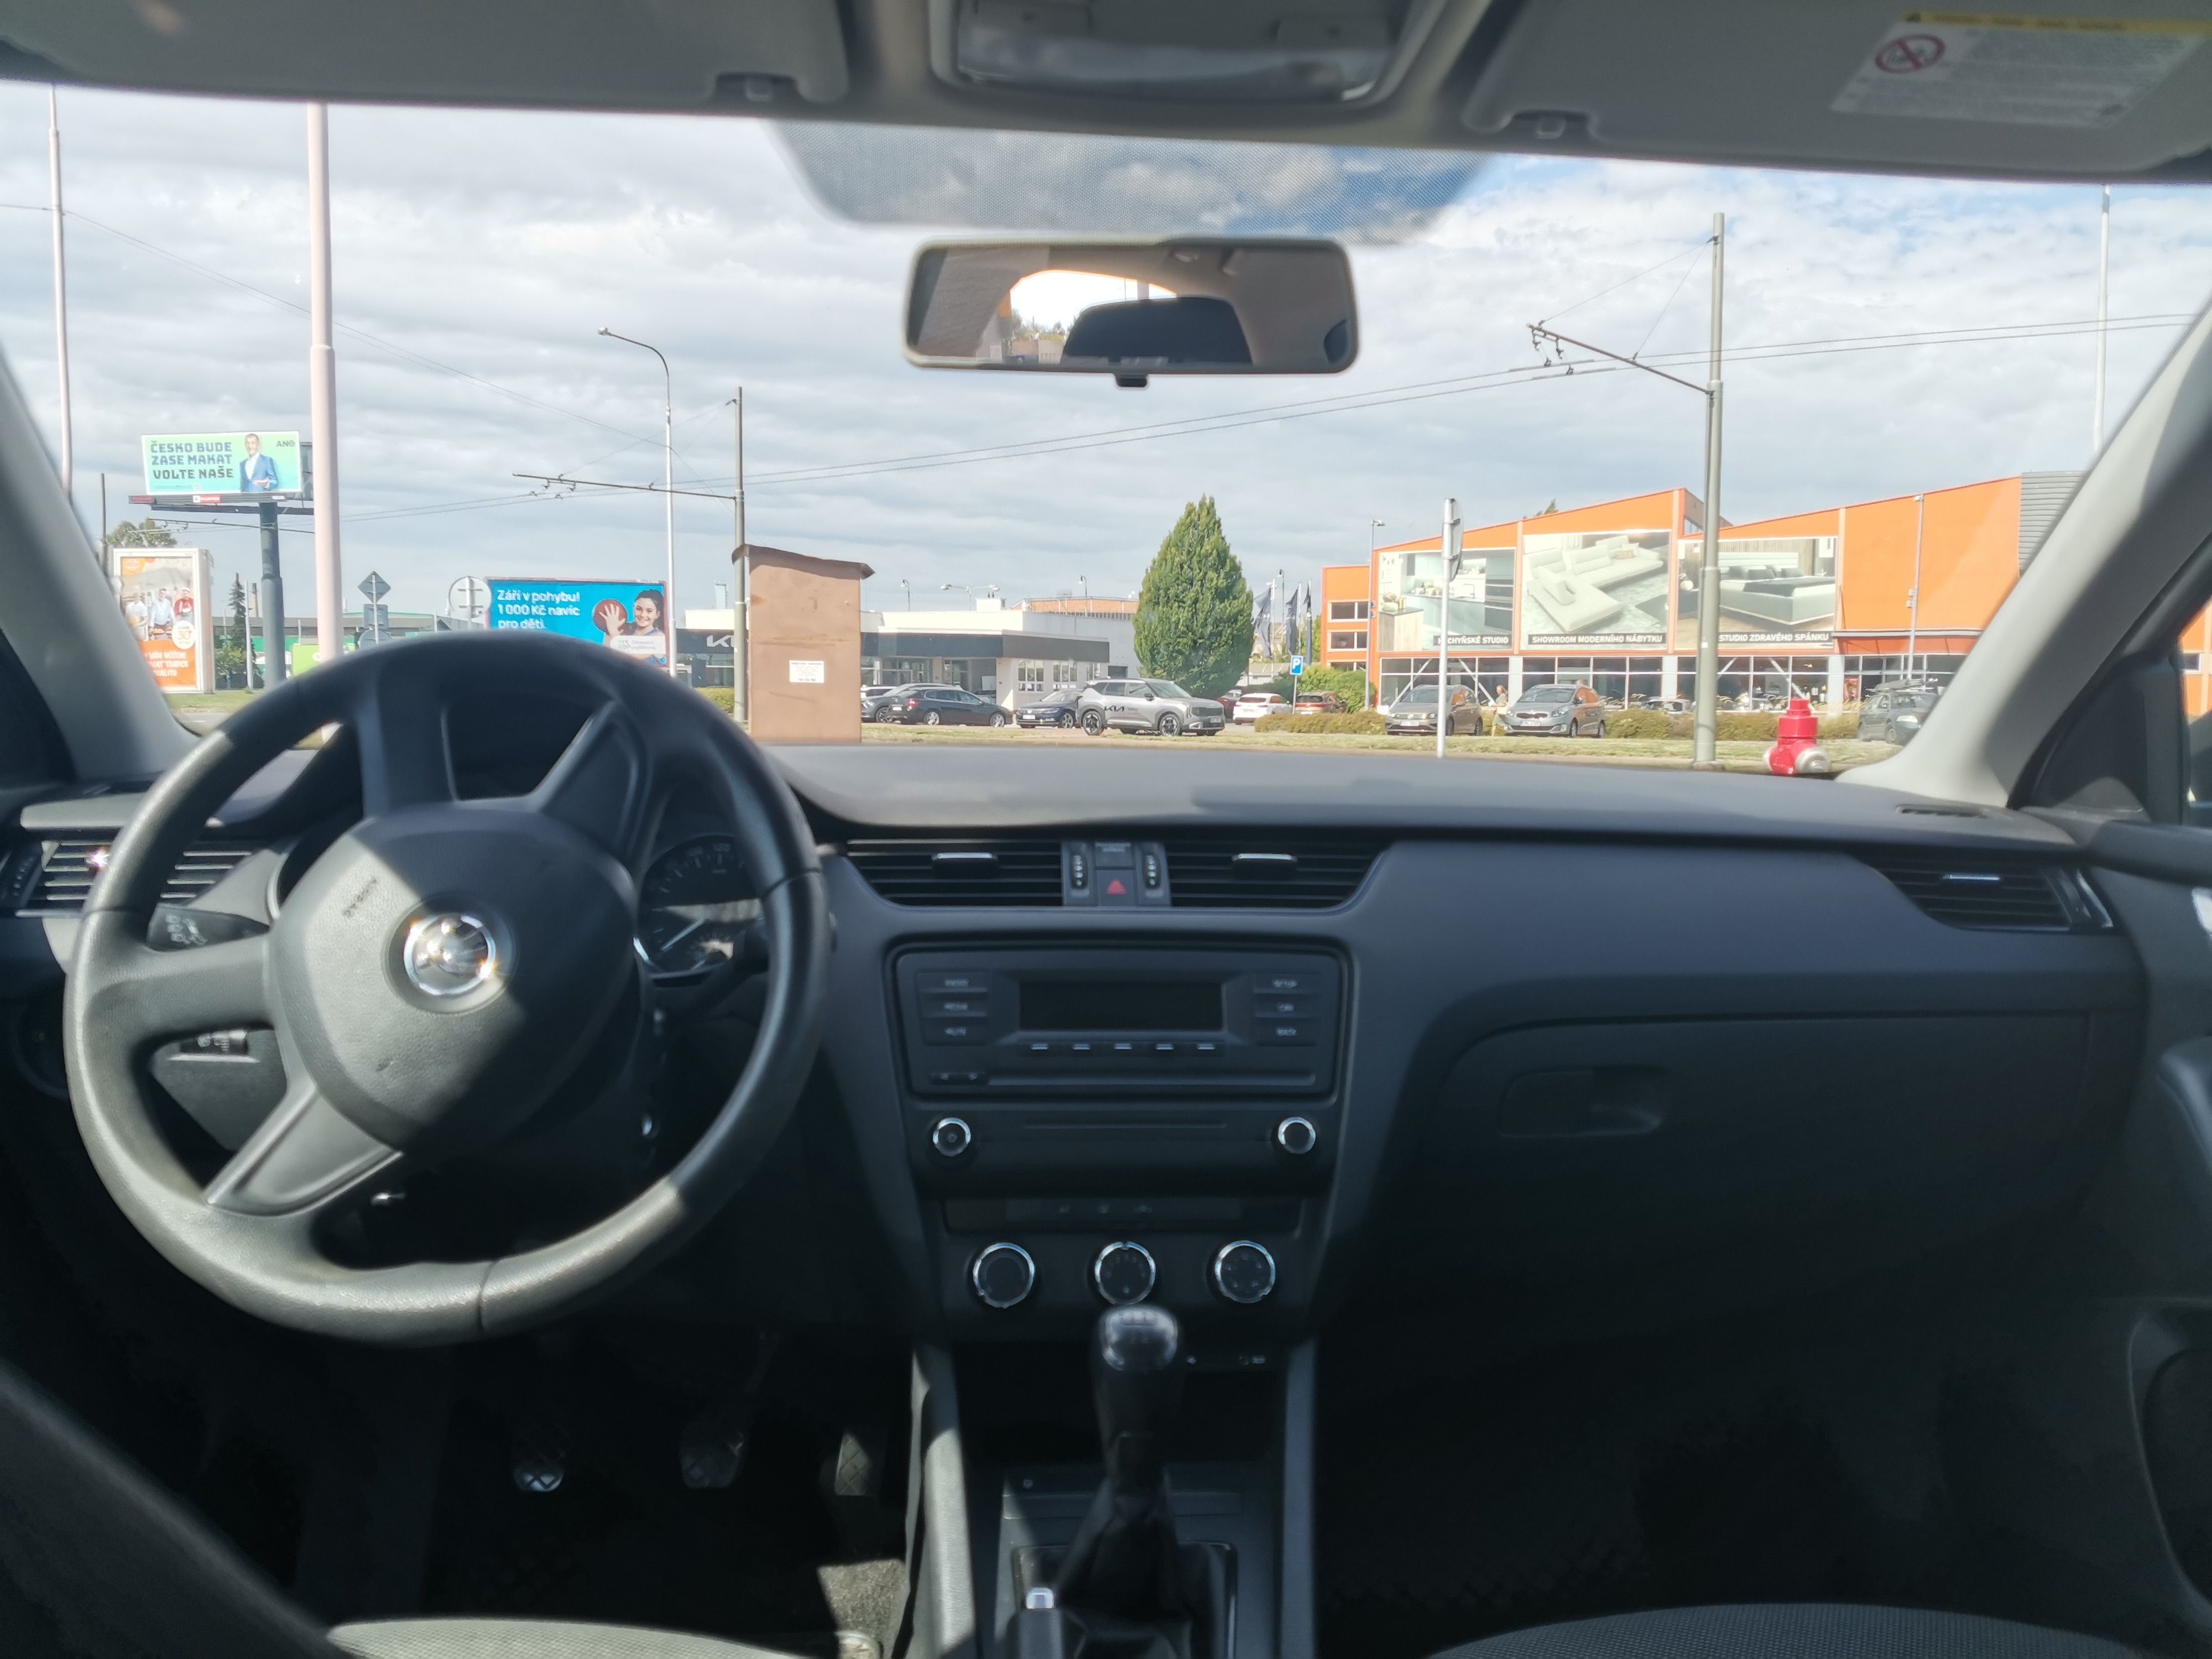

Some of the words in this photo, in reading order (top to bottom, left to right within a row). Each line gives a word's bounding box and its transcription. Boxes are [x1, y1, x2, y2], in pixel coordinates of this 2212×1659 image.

[150, 440, 193, 453] ČESKO
[196, 442, 232, 452] BUDE
[151, 455, 184, 466] ZASE
[187, 454, 232, 465] MAKAT
[153, 469, 195, 479] VOLTE
[199, 466, 234, 479] NAŠE
[497, 589, 521, 601] Září
[523, 592, 530, 601] v
[531, 591, 580, 604] pohybu!
[531, 604, 546, 615] Kč
[548, 605, 580, 615] navíc
[498, 620, 519, 629] pro
[1578, 634, 1624, 643] MODERNÍHO
[1625, 633, 1662, 642] NÁBYTKU
[1749, 632, 1793, 641] ZDRAVÉHO
[1794, 632, 1829, 641] SPÁNKU
[1293, 658, 1301, 669] P
